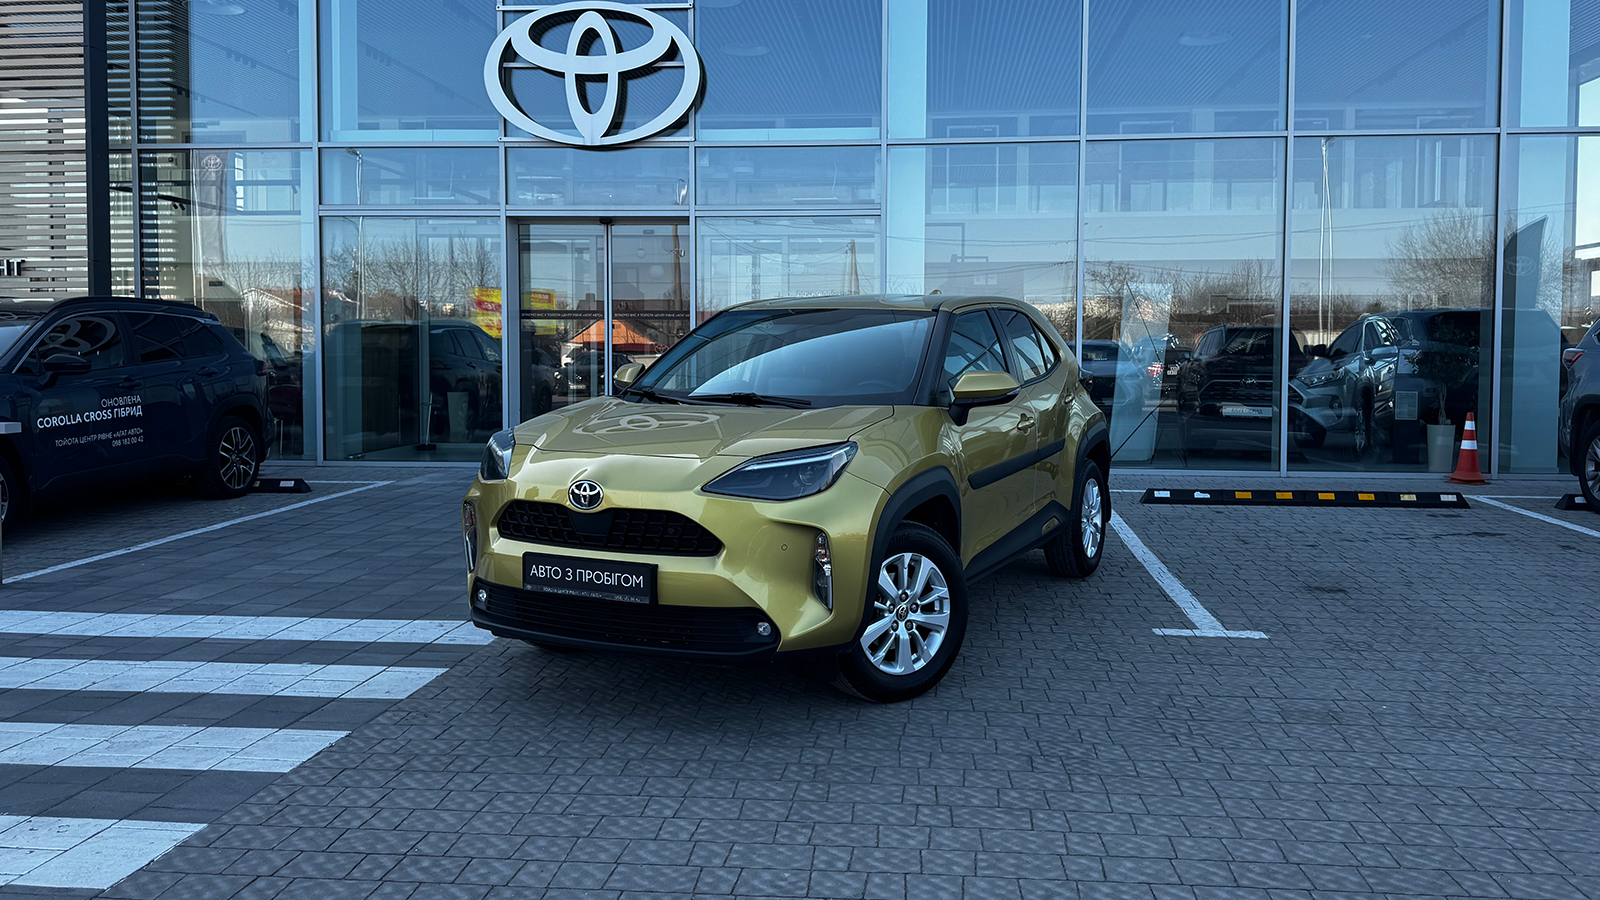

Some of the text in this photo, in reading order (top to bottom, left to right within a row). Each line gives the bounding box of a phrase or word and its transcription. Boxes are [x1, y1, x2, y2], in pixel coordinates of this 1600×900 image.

[101, 395, 141, 408] ОНОВЛЕНА
[37, 405, 143, 428] COROLLA CROSS ГІБРИД
[55, 437, 79, 447] ТОЙОТА
[79, 434, 97, 444] ЦЕНТР
[97, 431, 113, 441] РІВНЕ
[530, 564, 562, 580] АВТО
[576, 568, 644, 589] ПРОБІГОМ
